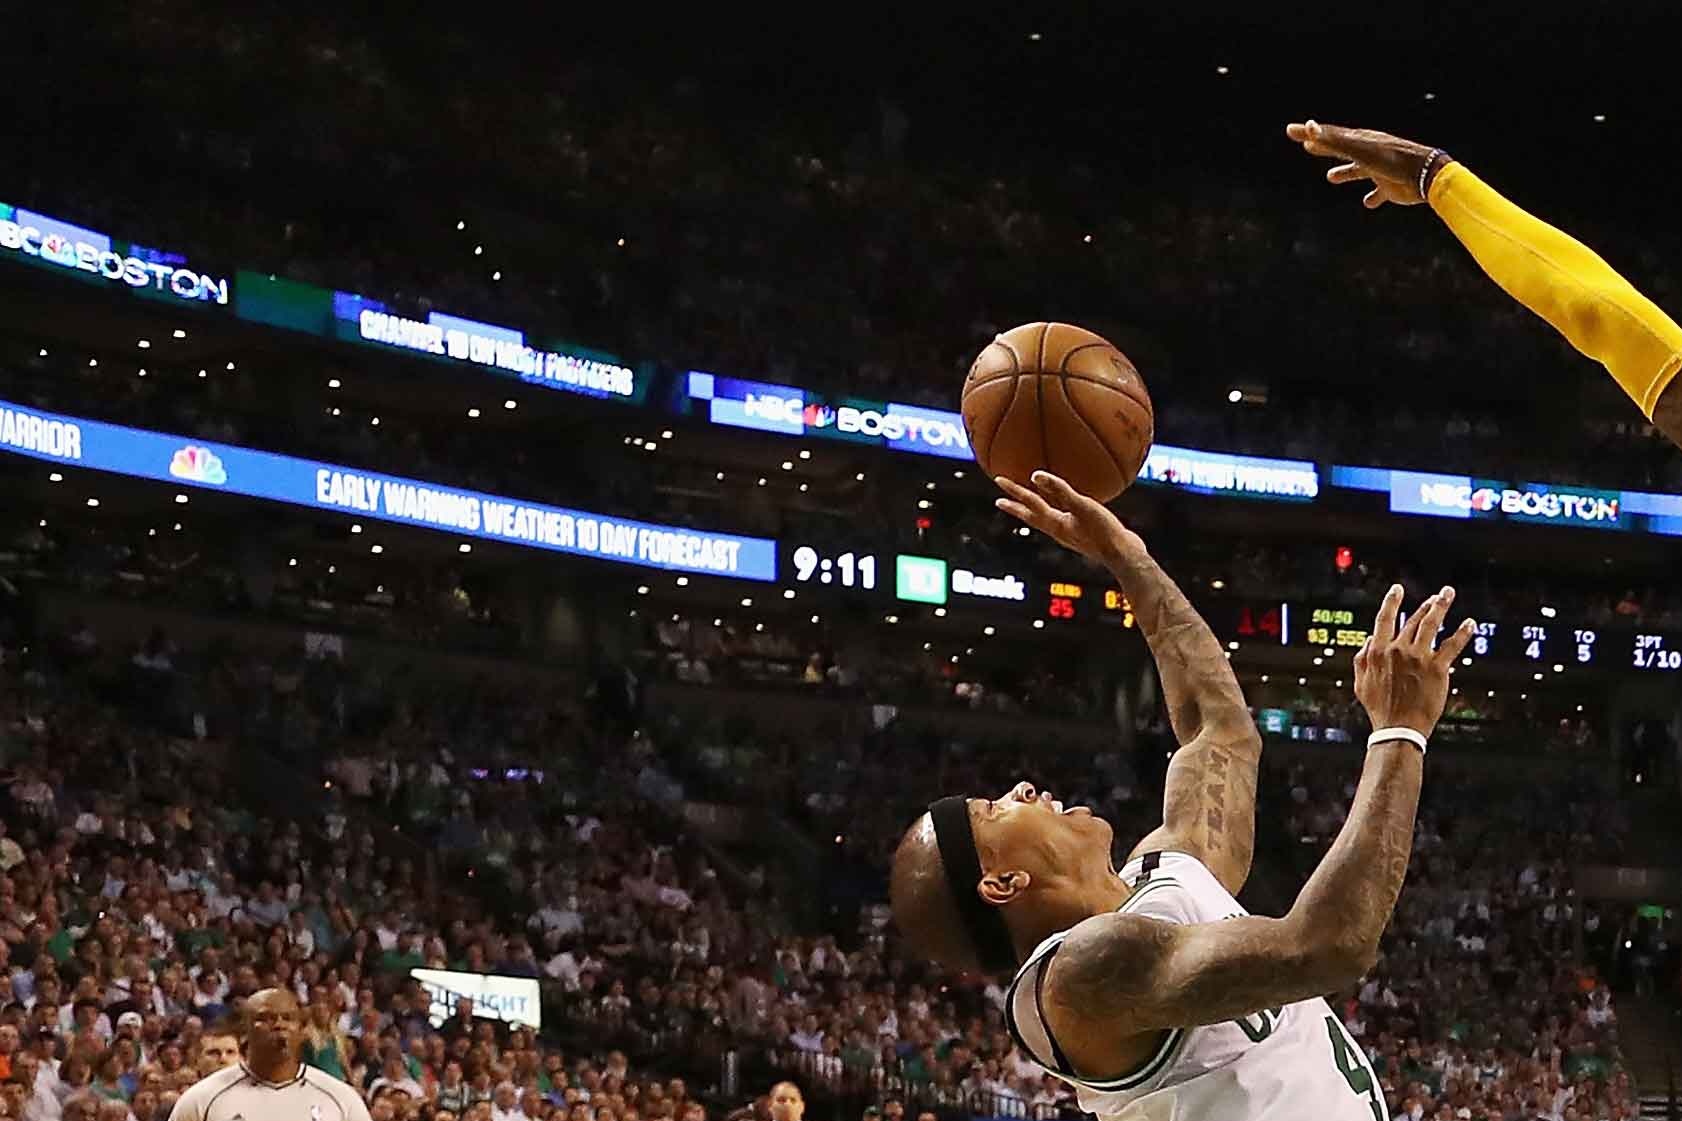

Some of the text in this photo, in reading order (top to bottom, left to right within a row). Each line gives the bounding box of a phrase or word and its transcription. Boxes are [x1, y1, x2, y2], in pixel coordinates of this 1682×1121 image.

[0, 219, 229, 304] BC BOSTON
[0, 407, 81, 460] ARRIOR
[838, 407, 967, 449] BOSTON
[1501, 489, 1618, 522] BOSTON
[316, 468, 741, 572] EARLY WARNING WEATHER 10 DAY FORECAST
[793, 546, 875, 589] 9:11
[1312, 609, 1353, 625] 50/50
[1522, 626, 1546, 641] STL
[1574, 630, 1595, 644] TO
[1635, 635, 1662, 649] 3PT
[1474, 637, 1488, 654] 8
[1525, 642, 1541, 659] 4
[1577, 644, 1592, 662] 5
[1632, 649, 1682, 668] 1/10
